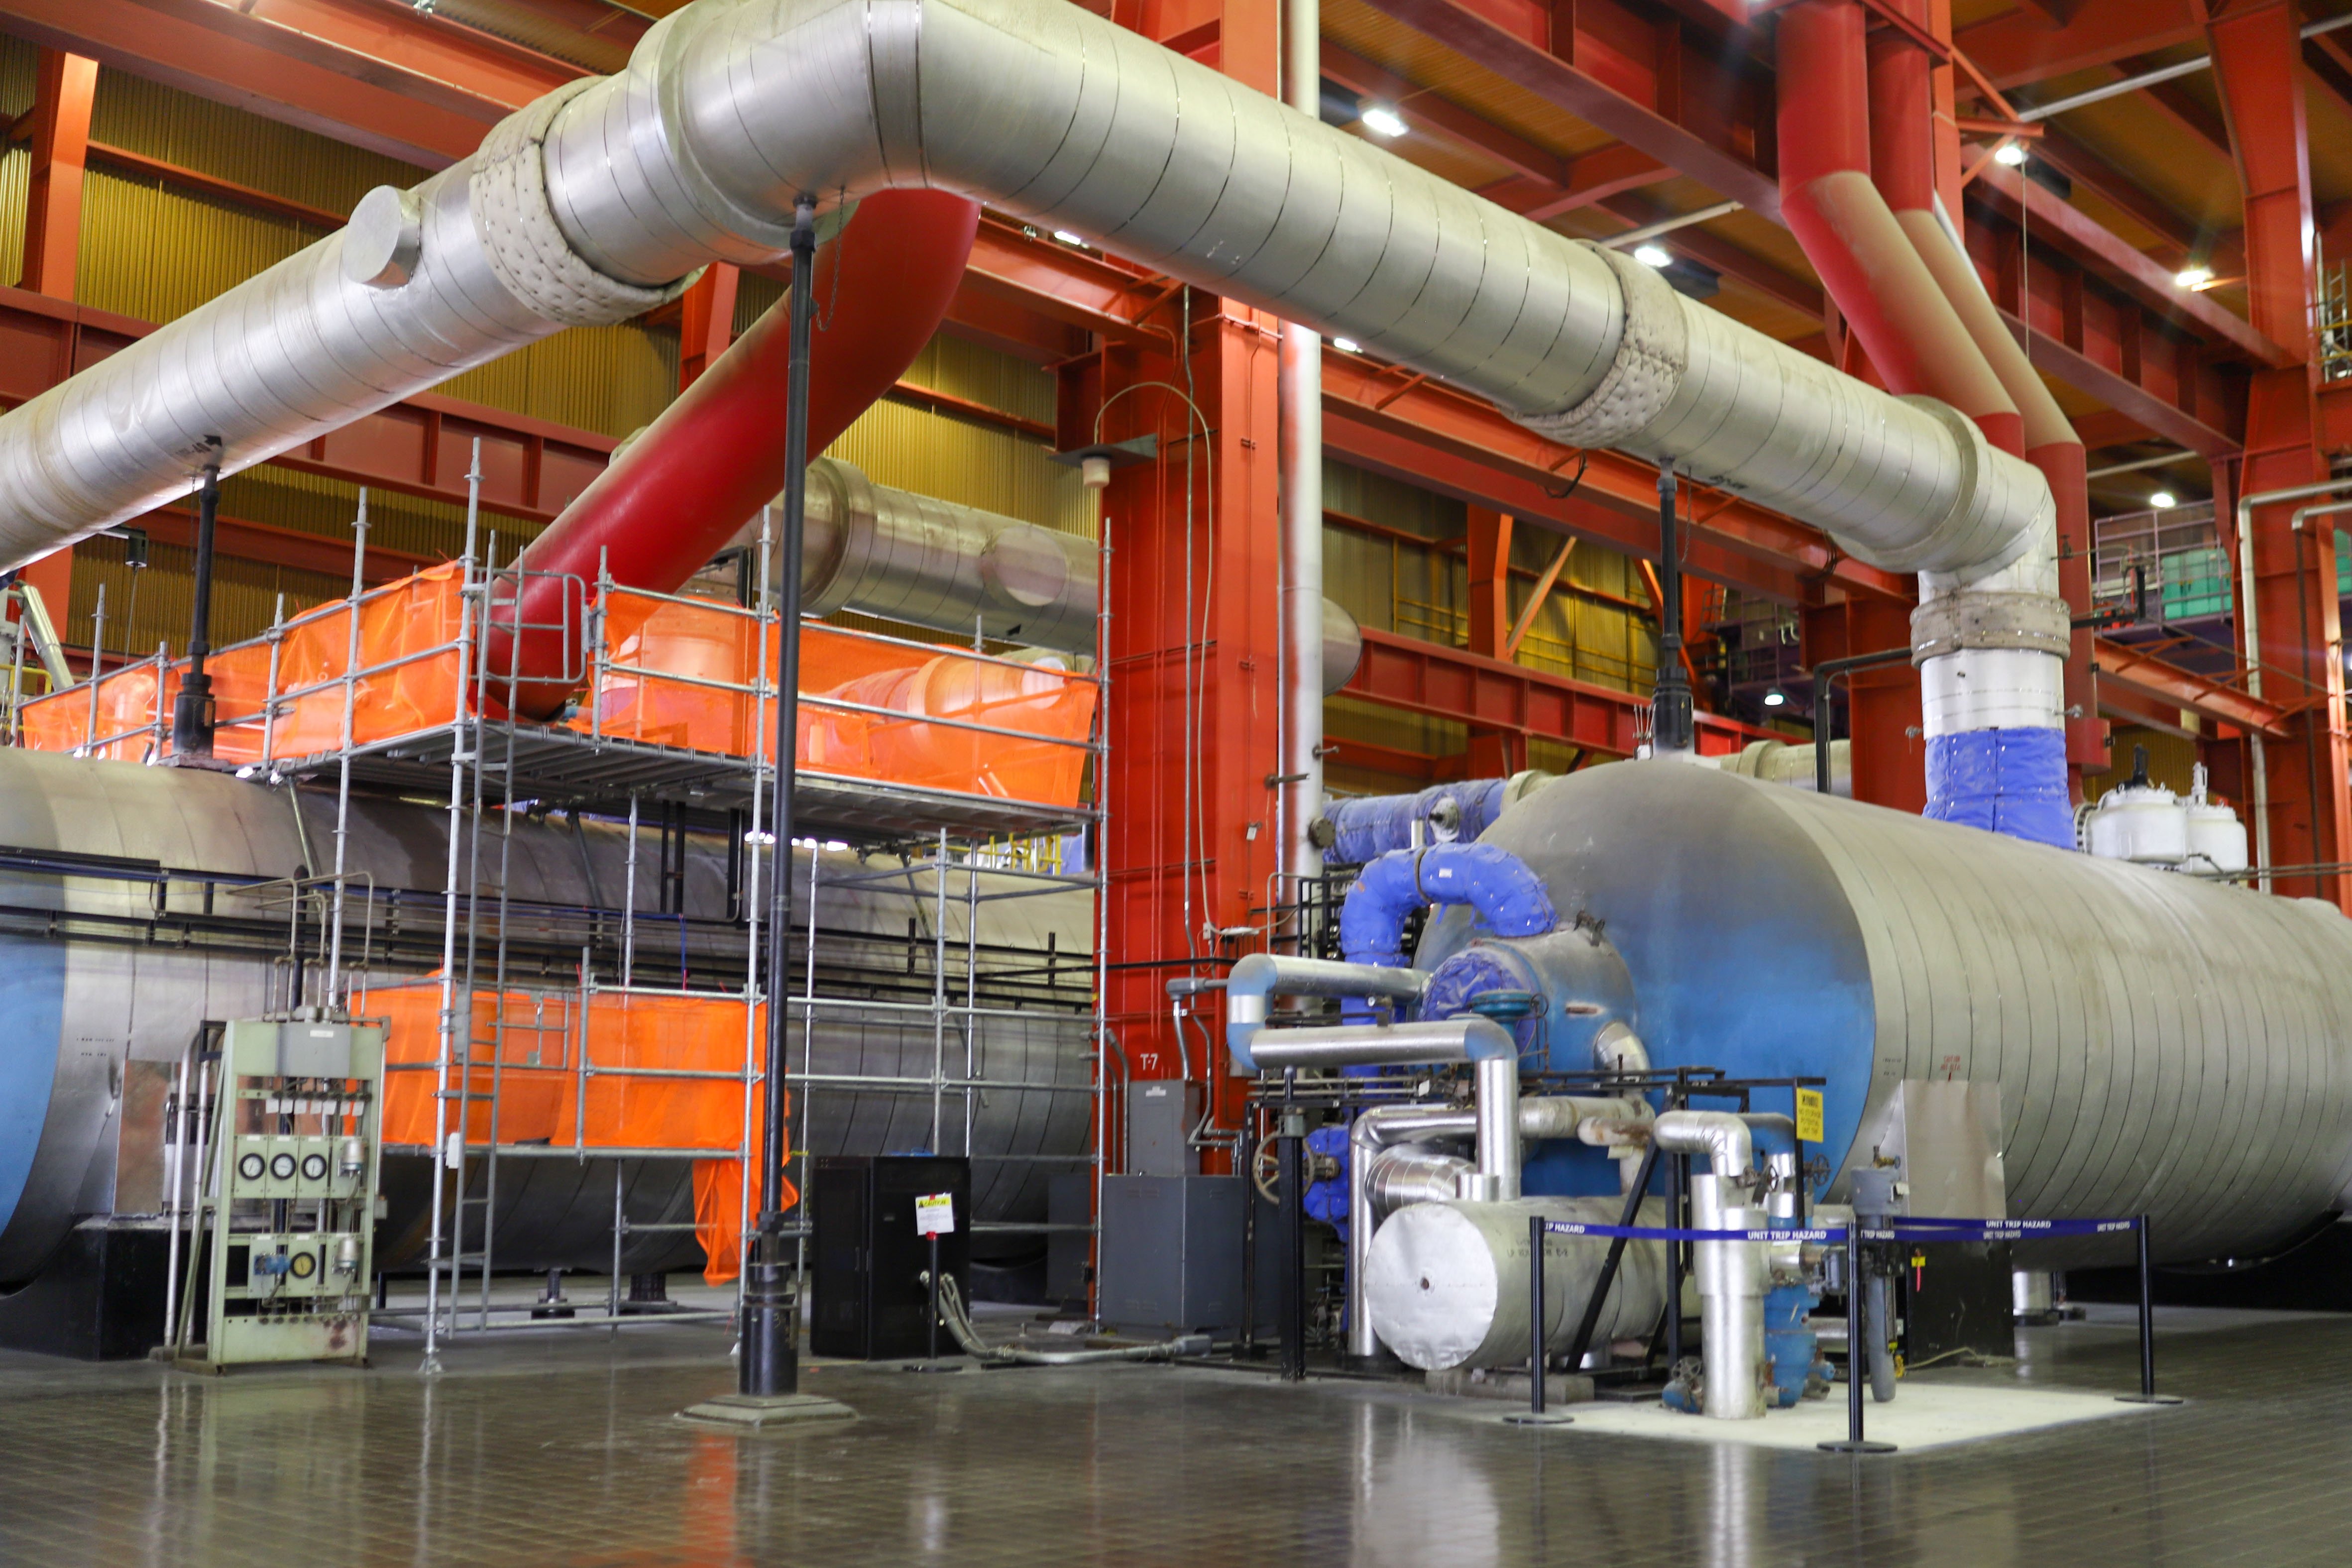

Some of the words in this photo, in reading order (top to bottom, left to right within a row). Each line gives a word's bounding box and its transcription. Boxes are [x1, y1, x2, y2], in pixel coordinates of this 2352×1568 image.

[1555, 1224, 1585, 1234] HAZARD
[1748, 1231, 1769, 1239] UNIT
[1771, 1231, 1791, 1239] TRIP
[1792, 1231, 1826, 1239] HAZARD
